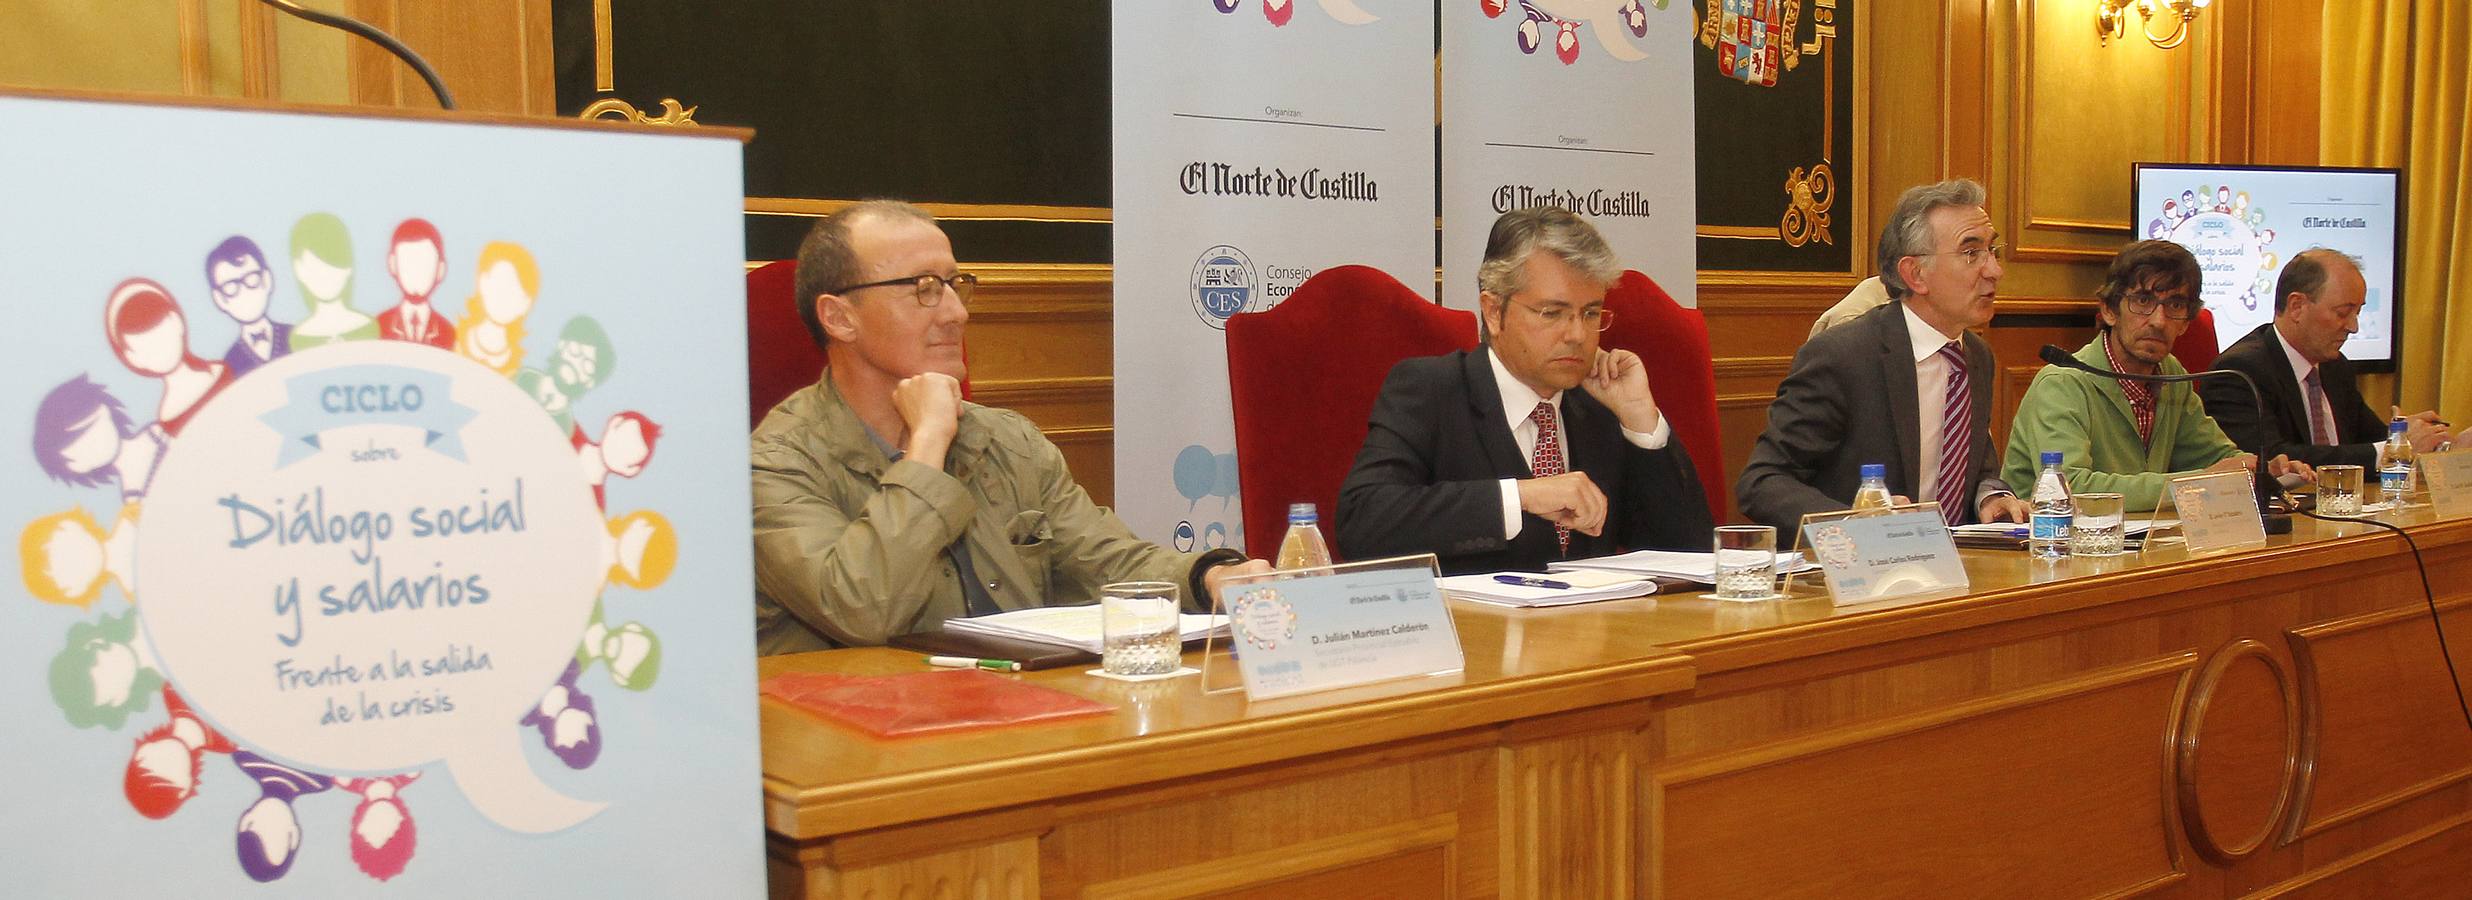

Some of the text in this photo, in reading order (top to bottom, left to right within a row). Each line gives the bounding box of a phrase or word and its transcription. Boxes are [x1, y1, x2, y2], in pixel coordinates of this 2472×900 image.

[1264, 105, 1303, 118] Organizan:
[1180, 161, 1378, 202] El Norte de Castilla
[1492, 184, 1650, 218] El Norte de Castilla
[1266, 264, 1312, 283] Consejo
[1207, 290, 1241, 312] CES
[320, 384, 424, 414] CICLO
[351, 438, 402, 462] sobre
[217, 477, 526, 565] Diálogo social
[275, 557, 491, 647] y salarios
[274, 644, 493, 691] Frente a la salida
[320, 688, 455, 725] de la crisis
